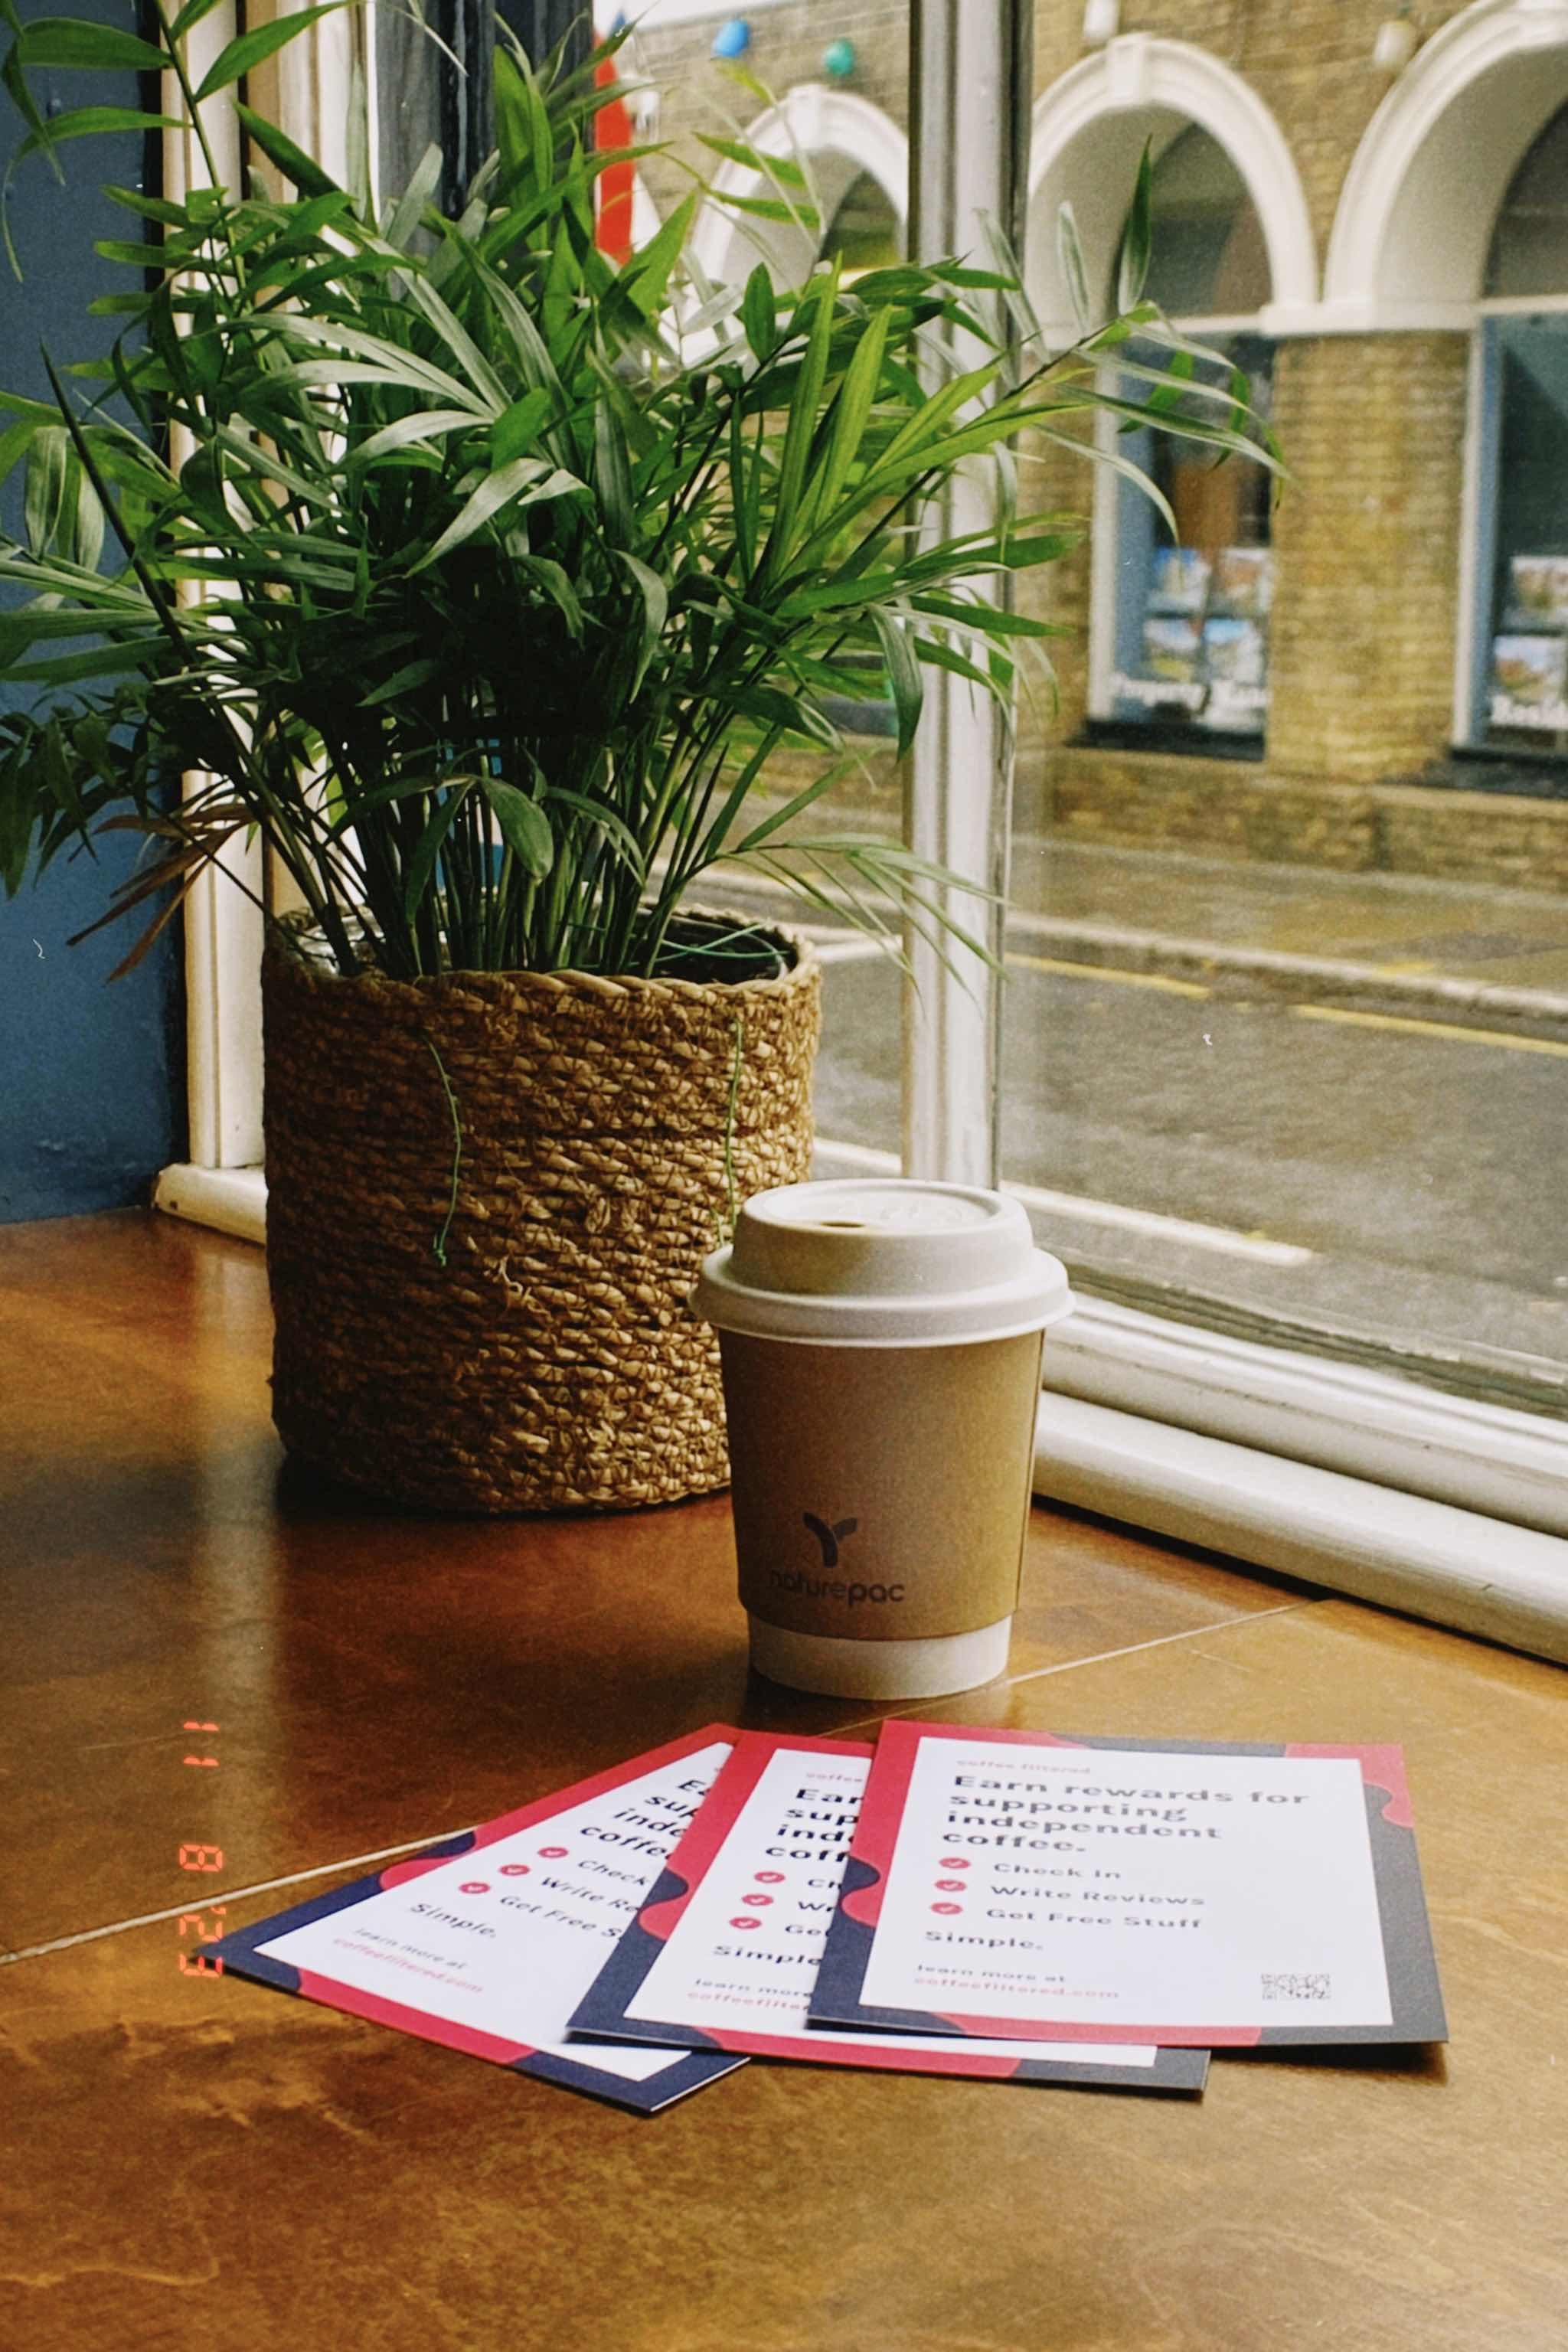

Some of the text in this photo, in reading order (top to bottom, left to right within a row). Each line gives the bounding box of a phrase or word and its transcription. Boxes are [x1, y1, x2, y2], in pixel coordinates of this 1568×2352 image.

[771, 1570, 904, 1608] naturepac
[955, 1775, 1310, 1803] Earn rewards for
[949, 1795, 1187, 1822] supporting
[947, 1811, 1223, 1838] independent
[580, 1827, 673, 1860] coffe
[942, 1833, 1086, 1852] coffee.
[578, 1860, 649, 1885] Check
[993, 1863, 1084, 1878] Check
[541, 1877, 605, 1902] Write
[990, 1886, 1206, 1906] Write Reviews
[410, 1903, 496, 1939] Simple.
[500, 1896, 543, 1913] Get
[544, 1910, 597, 1930] Free
[986, 1909, 1202, 1929] Get Free Stuff
[925, 1930, 1044, 1949] Simple.
[918, 1965, 973, 1976] learn
[982, 1971, 1037, 1981] more
[914, 1978, 1119, 1999] coffeefiltered.com
